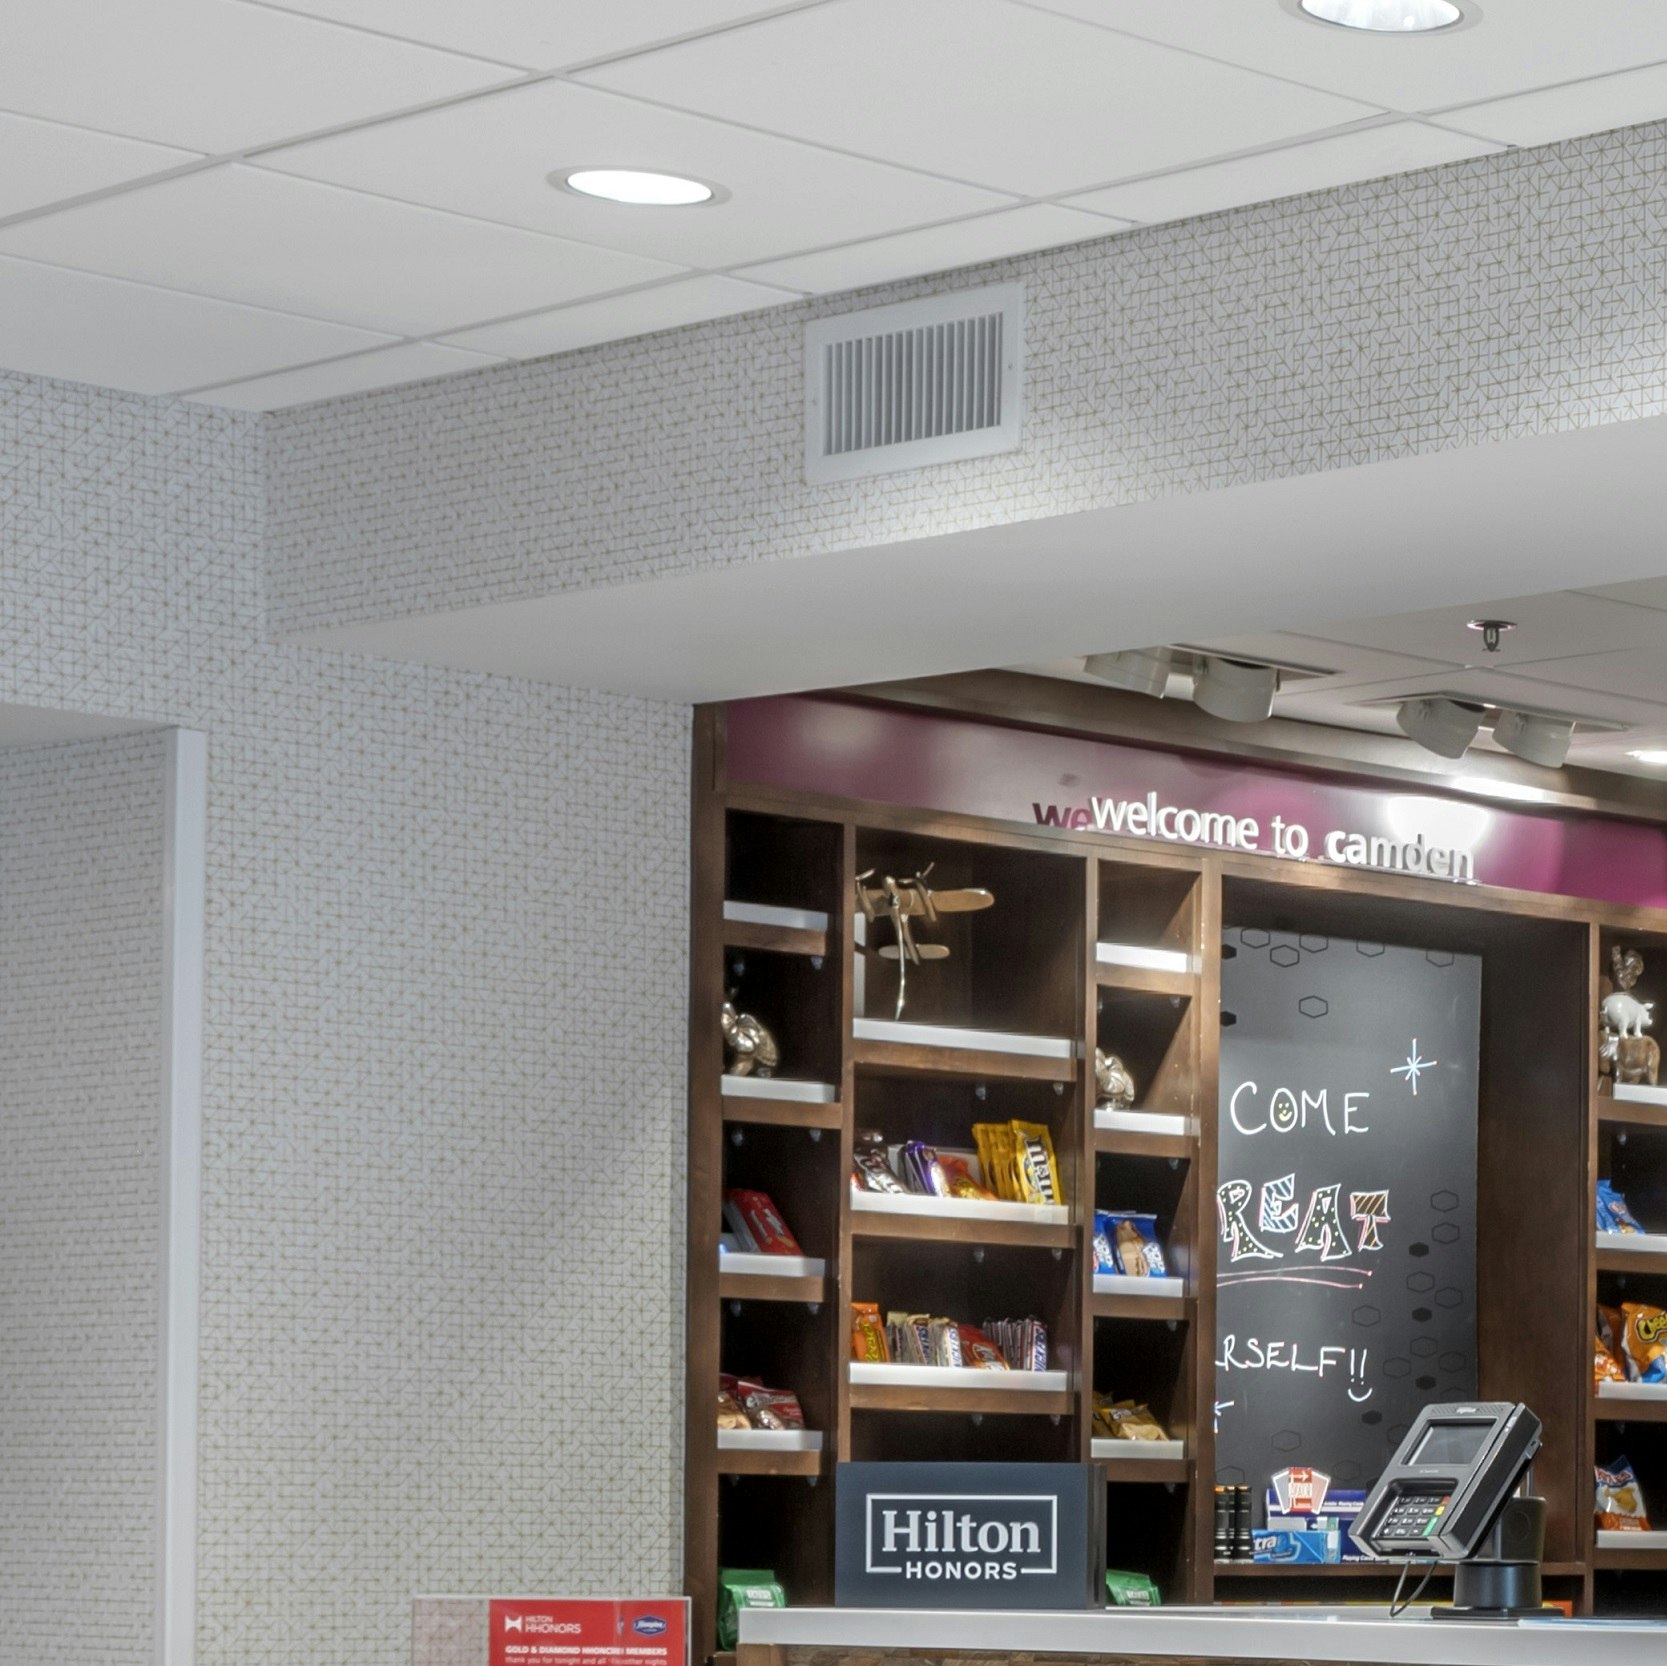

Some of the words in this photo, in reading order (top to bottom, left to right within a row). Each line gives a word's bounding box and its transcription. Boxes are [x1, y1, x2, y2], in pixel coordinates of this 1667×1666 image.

[1091, 791, 1260, 851] welcome
[1271, 815, 1309, 857] to
[1324, 829, 1474, 880] camden
[1230, 1081, 1370, 1136] COME
[1216, 1335, 1368, 1385] RSELF!!
[882, 1510, 1042, 1553] Hilton
[905, 1561, 1018, 1580] HONORS
[525, 1623, 582, 1635] HHONORS
